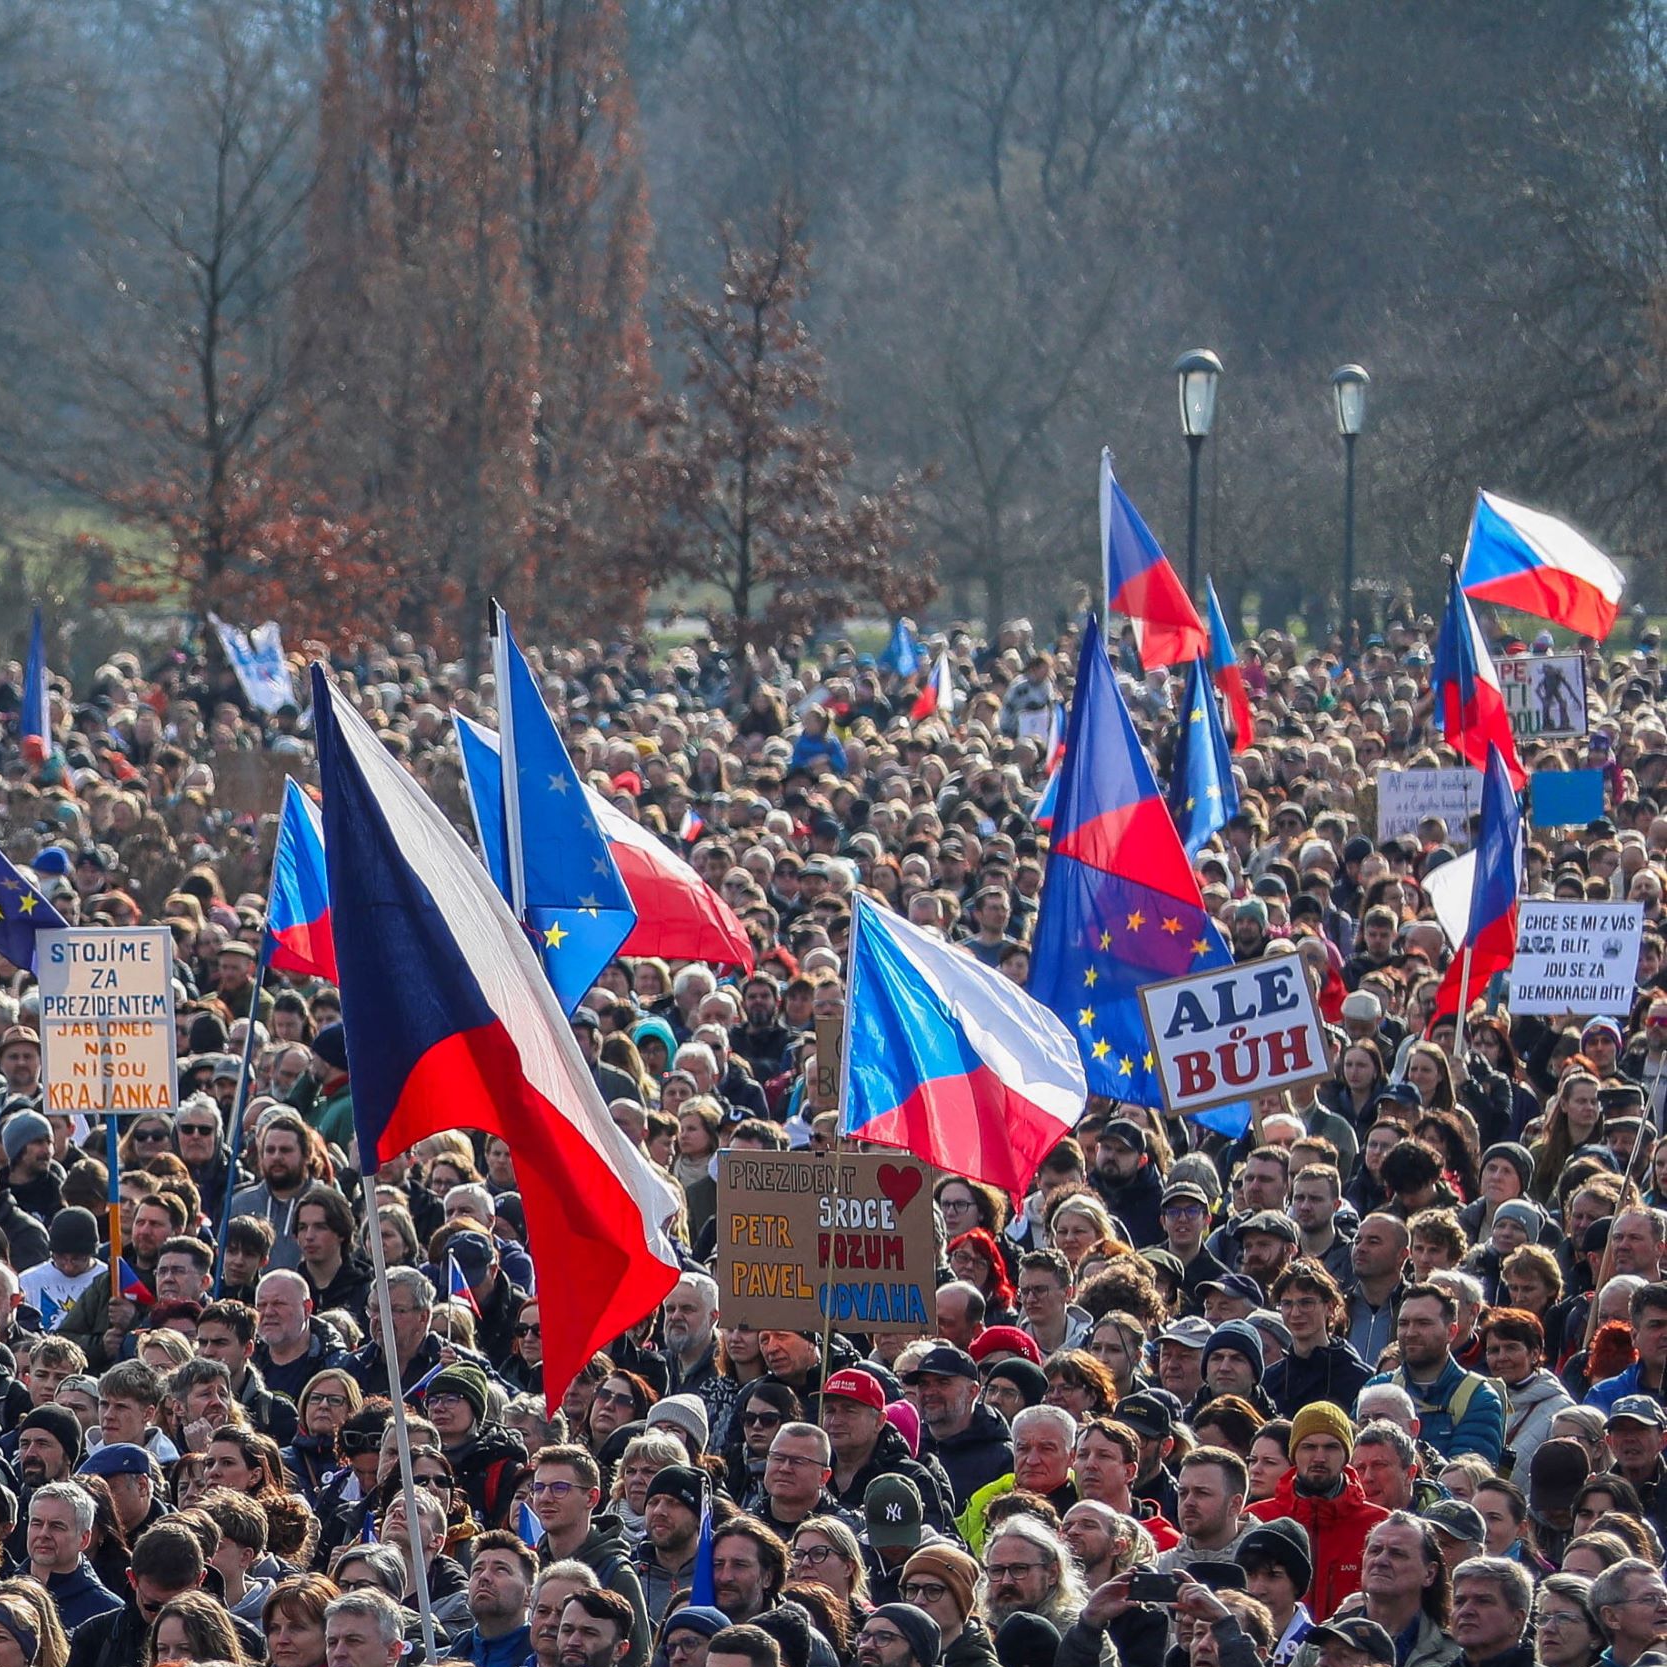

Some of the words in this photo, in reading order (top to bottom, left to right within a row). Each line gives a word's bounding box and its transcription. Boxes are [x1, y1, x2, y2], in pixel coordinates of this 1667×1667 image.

[1525, 914, 1559, 932] CHCE
[1562, 915, 1578, 932] SE
[1581, 915, 1597, 932] MI
[1600, 916, 1609, 931] Z
[1611, 912, 1636, 932] VÁS
[51, 938, 151, 963] STOJÍME
[1560, 936, 1591, 955] BLÍT,
[90, 968, 118, 989] ZA
[1543, 962, 1567, 978] JDU
[1569, 962, 1585, 978] SE
[1588, 962, 1605, 978] ZA
[1163, 965, 1300, 1039] ALE
[1518, 984, 1597, 1001] DEMOKRACII
[57, 1021, 153, 1037] JABLONEC
[84, 1042, 127, 1056] NAD
[1172, 1024, 1313, 1098] BŮH
[48, 1082, 171, 1110] KRAJANKA
[728, 1160, 857, 1195] PREZIDENT
[819, 1196, 897, 1230] SRDCE
[730, 1213, 794, 1248] PETR
[817, 1233, 905, 1271] ROZUM
[731, 1261, 814, 1299] PAVEL
[819, 1283, 928, 1324] ODVAHA
